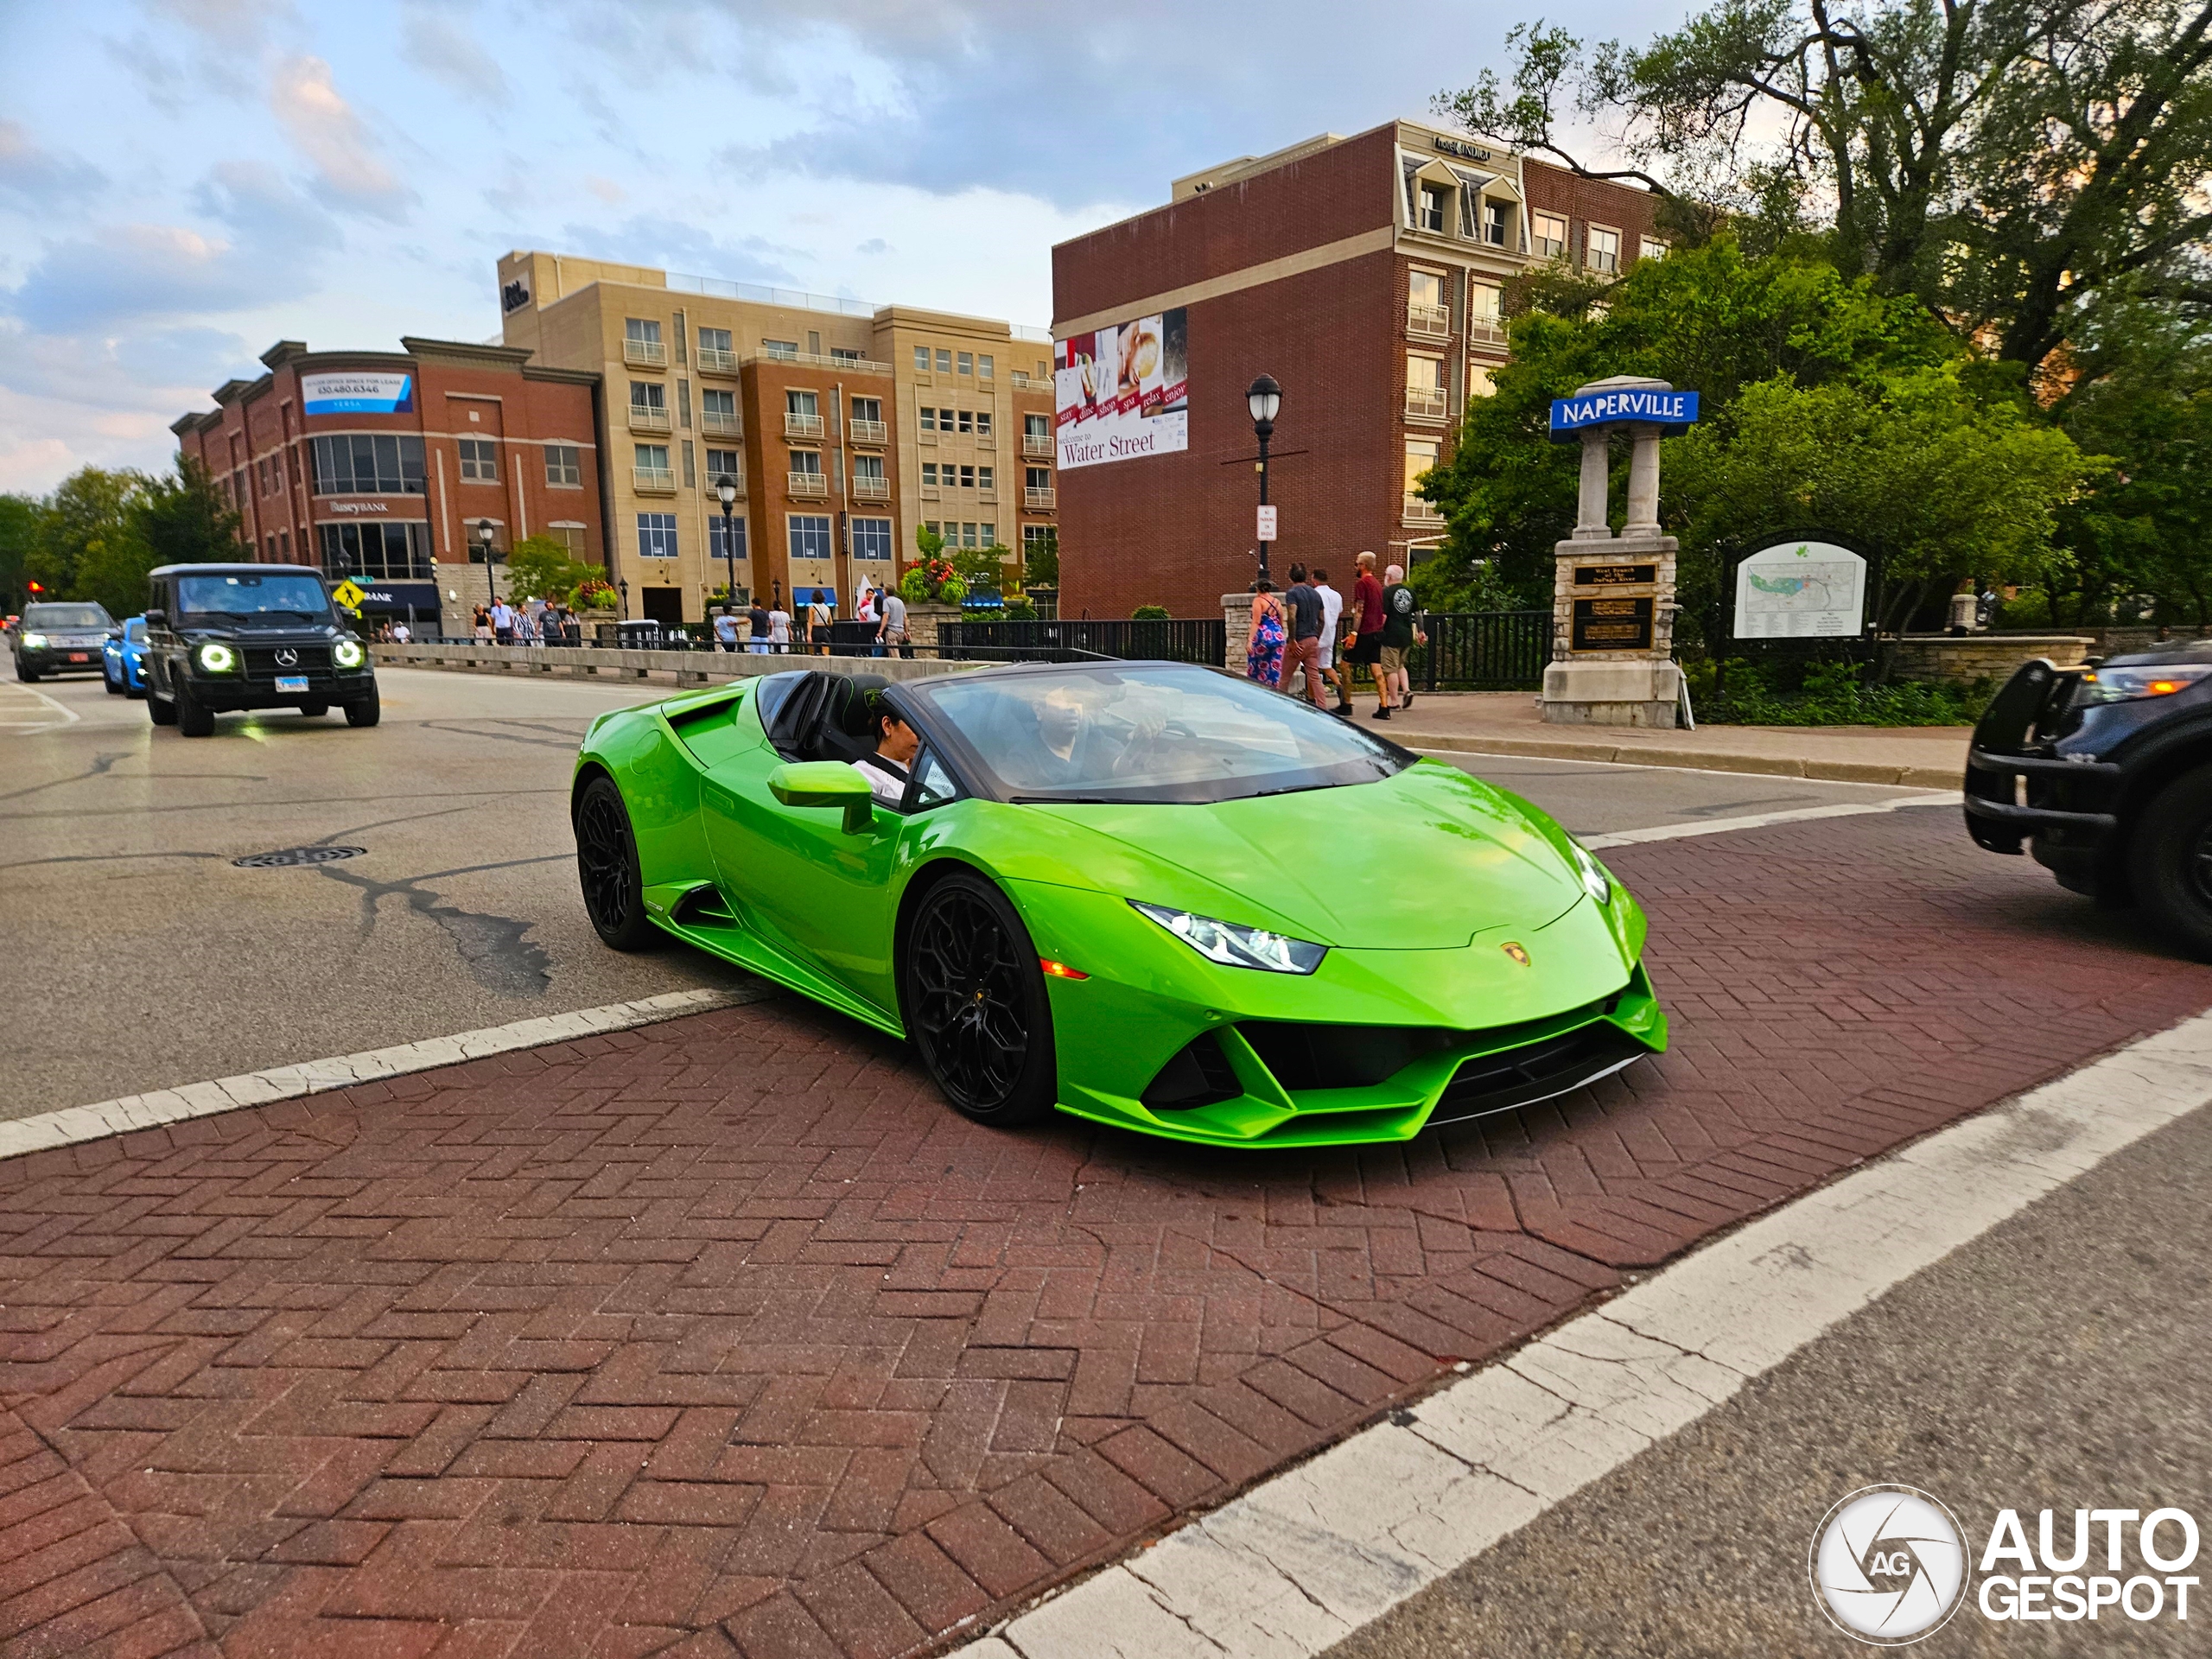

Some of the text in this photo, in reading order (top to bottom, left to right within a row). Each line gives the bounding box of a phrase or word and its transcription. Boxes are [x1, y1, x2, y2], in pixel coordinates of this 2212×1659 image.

[1435, 136, 1491, 160] hotel INDIGO
[1143, 391, 1161, 408] relax
[1165, 384, 1186, 403] enjoy
[1098, 399, 1116, 416] shop
[1122, 396, 1136, 411] spa
[1562, 393, 1684, 423] NAPERVILLE
[1059, 408, 1074, 423] stay
[1078, 405, 1095, 421] dine
[1058, 432, 1092, 445] welcome to
[1065, 430, 1156, 465] Water Street
